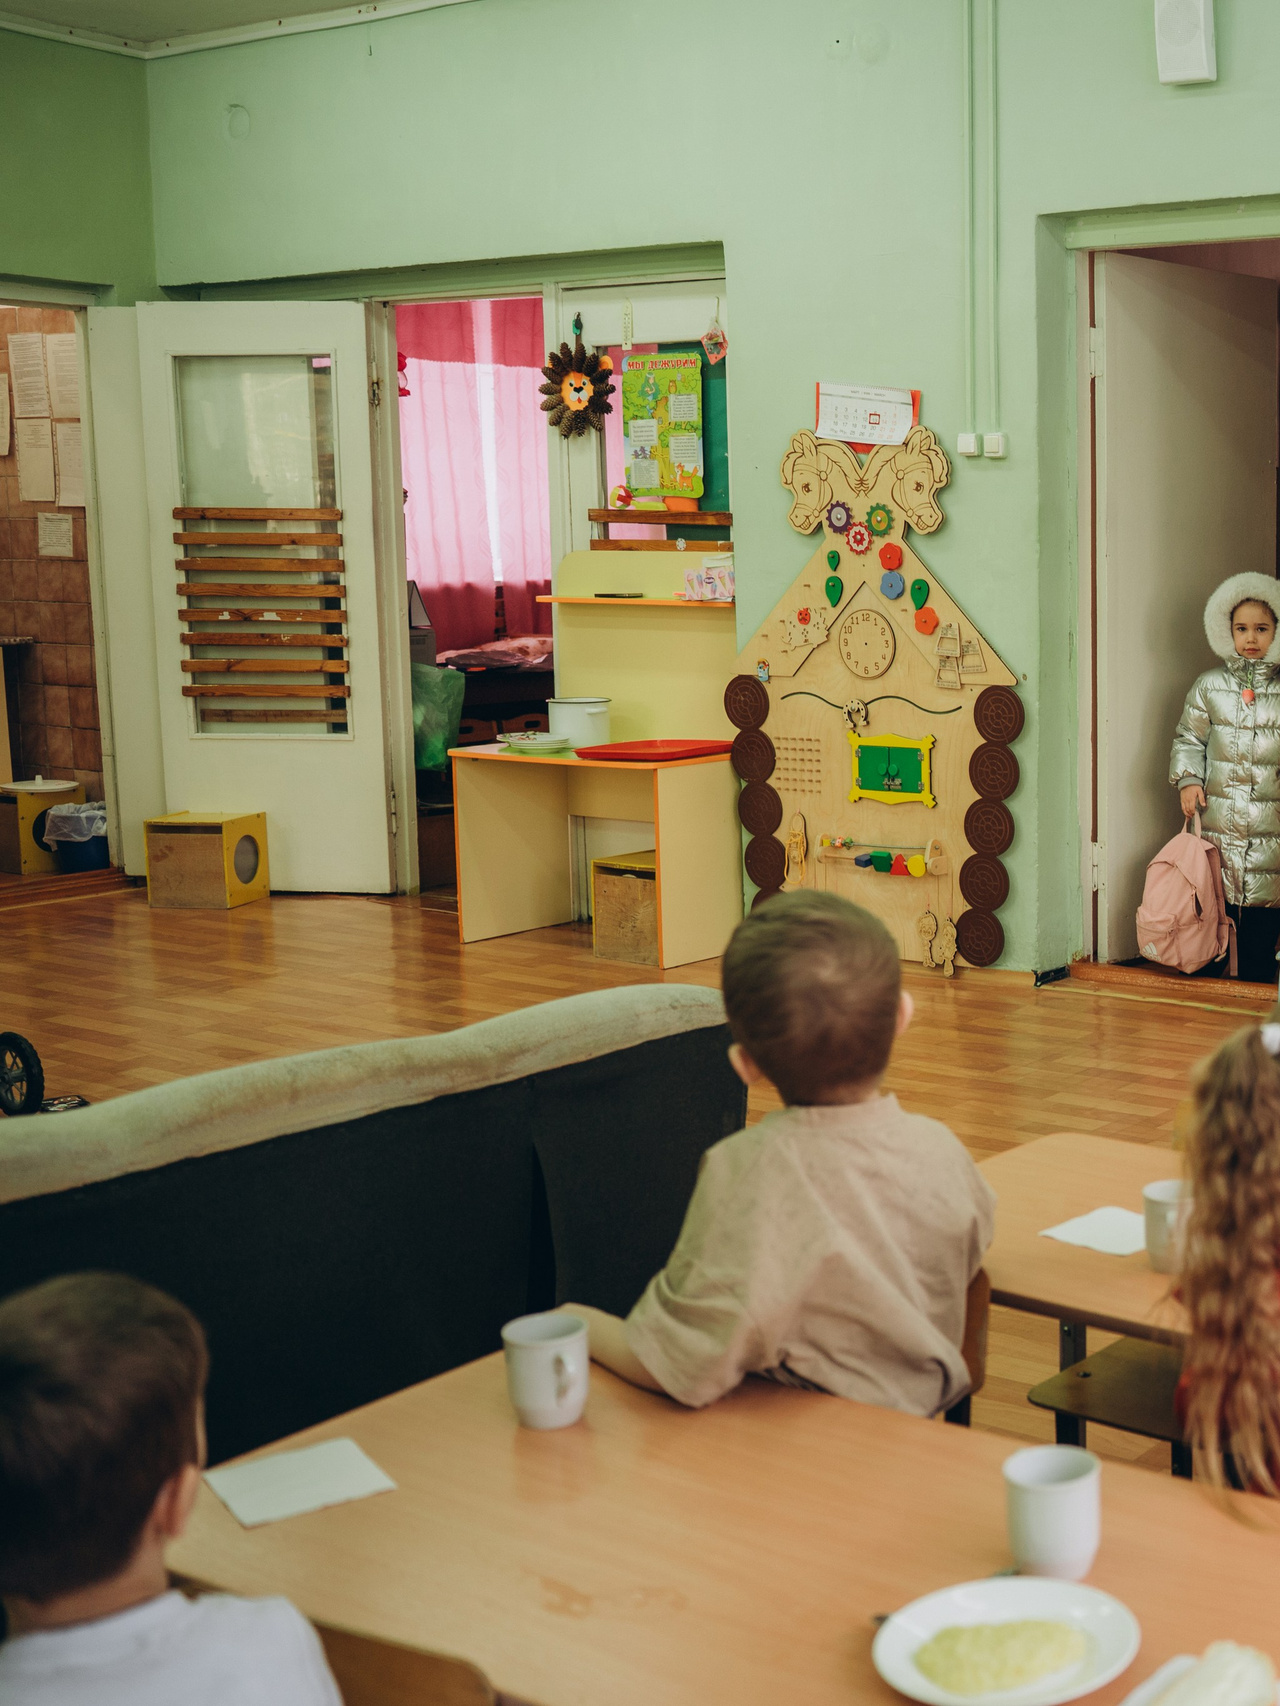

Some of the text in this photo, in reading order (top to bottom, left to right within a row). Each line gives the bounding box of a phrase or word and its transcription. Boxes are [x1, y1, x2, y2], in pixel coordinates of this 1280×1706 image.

[627, 358, 696, 370] МЫ ДЕЖУРИМ
[851, 616, 859, 624] 11
[862, 613, 870, 621] 12
[844, 626, 852, 634] 10
[881, 627, 885, 635] 2
[843, 638, 848, 646] 9
[884, 640, 889, 648] 3
[847, 652, 851, 660] 8
[864, 666, 869, 674] 6
[875, 662, 879, 670] 5
